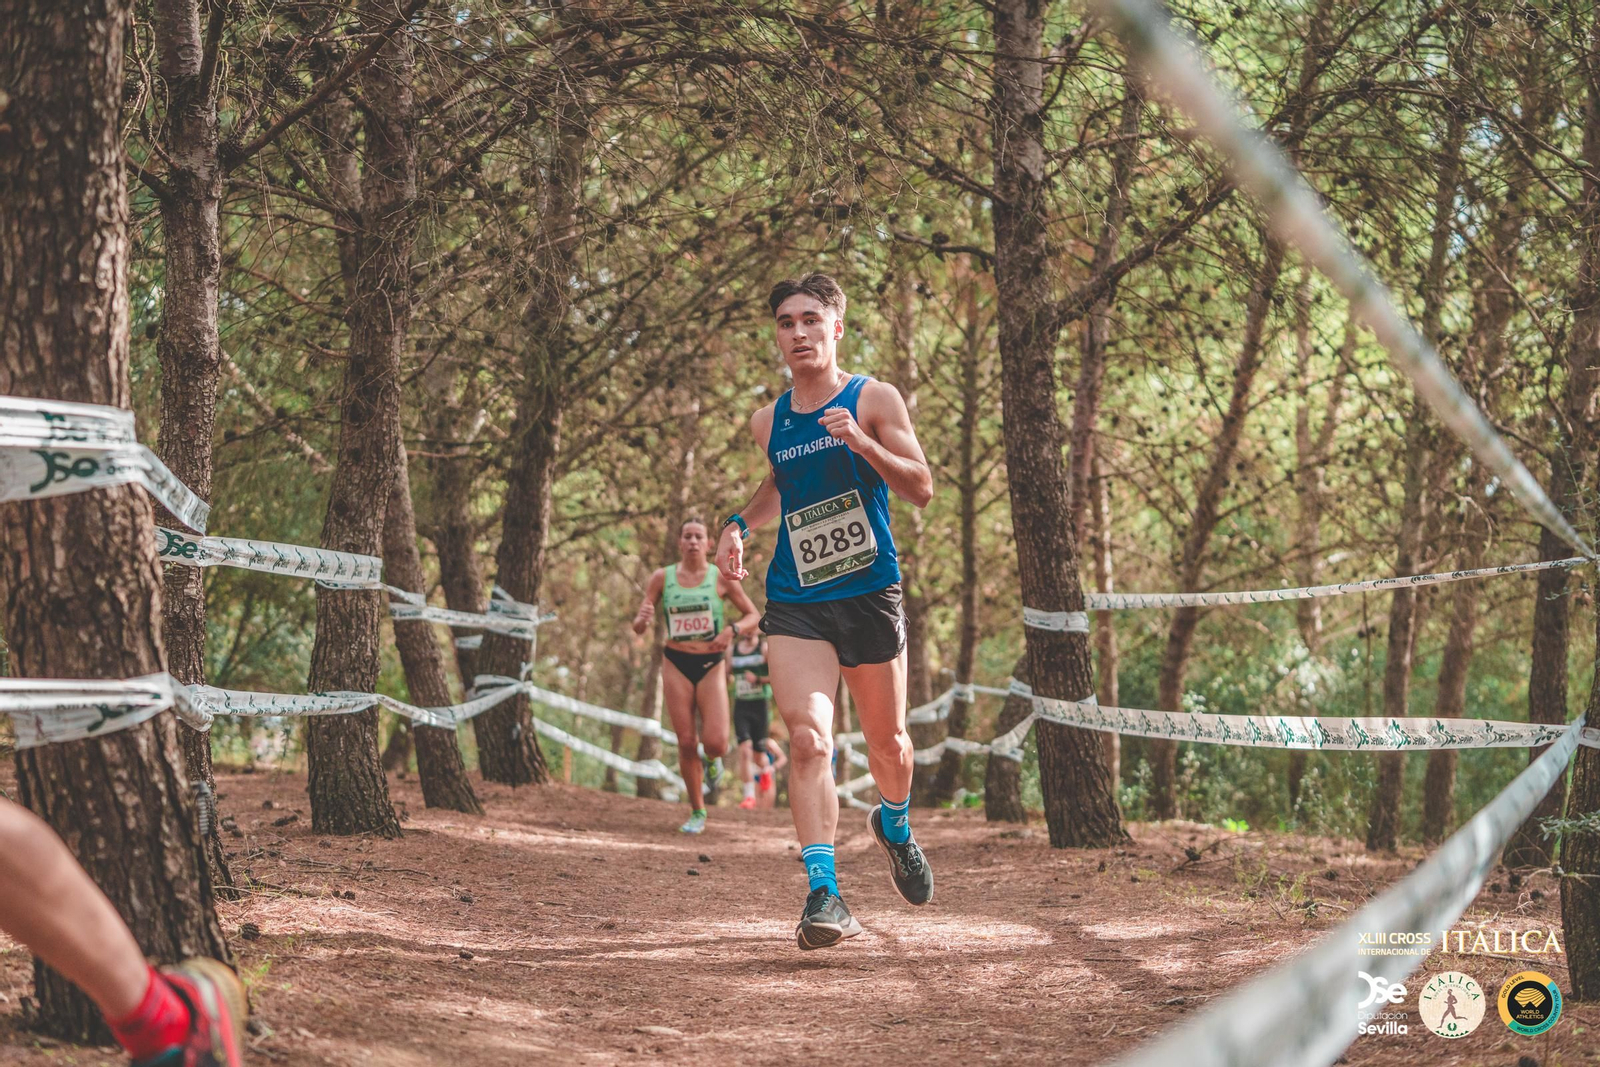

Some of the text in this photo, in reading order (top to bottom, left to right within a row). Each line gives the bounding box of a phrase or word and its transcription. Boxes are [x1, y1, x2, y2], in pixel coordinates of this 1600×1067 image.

[803, 501, 840, 520] ITÁLICA
[799, 521, 867, 564] 8289
[674, 616, 710, 633] 7602
